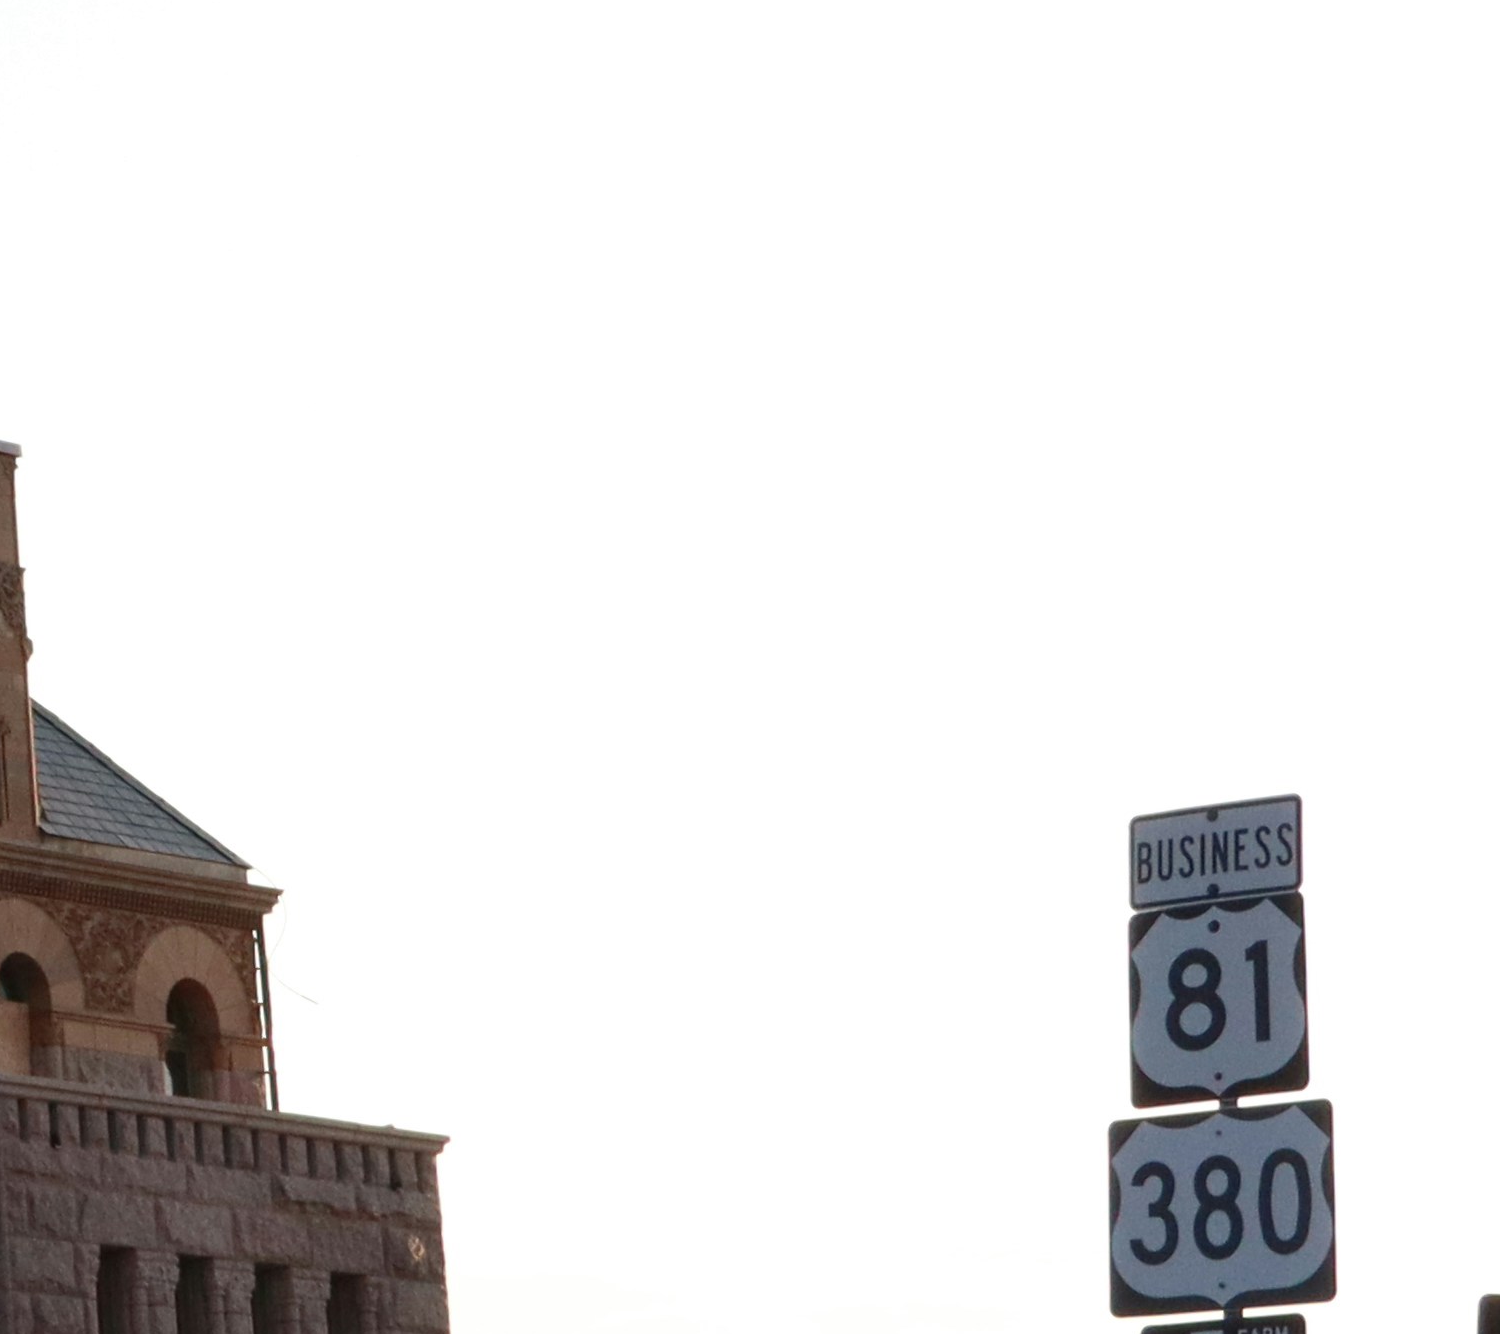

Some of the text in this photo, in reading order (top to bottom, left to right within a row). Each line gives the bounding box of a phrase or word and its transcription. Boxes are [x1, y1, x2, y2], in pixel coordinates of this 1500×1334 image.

[1135, 820, 1295, 885] BUSINESS
[1165, 939, 1272, 1053] 81
[1129, 1147, 1313, 1265] 380
